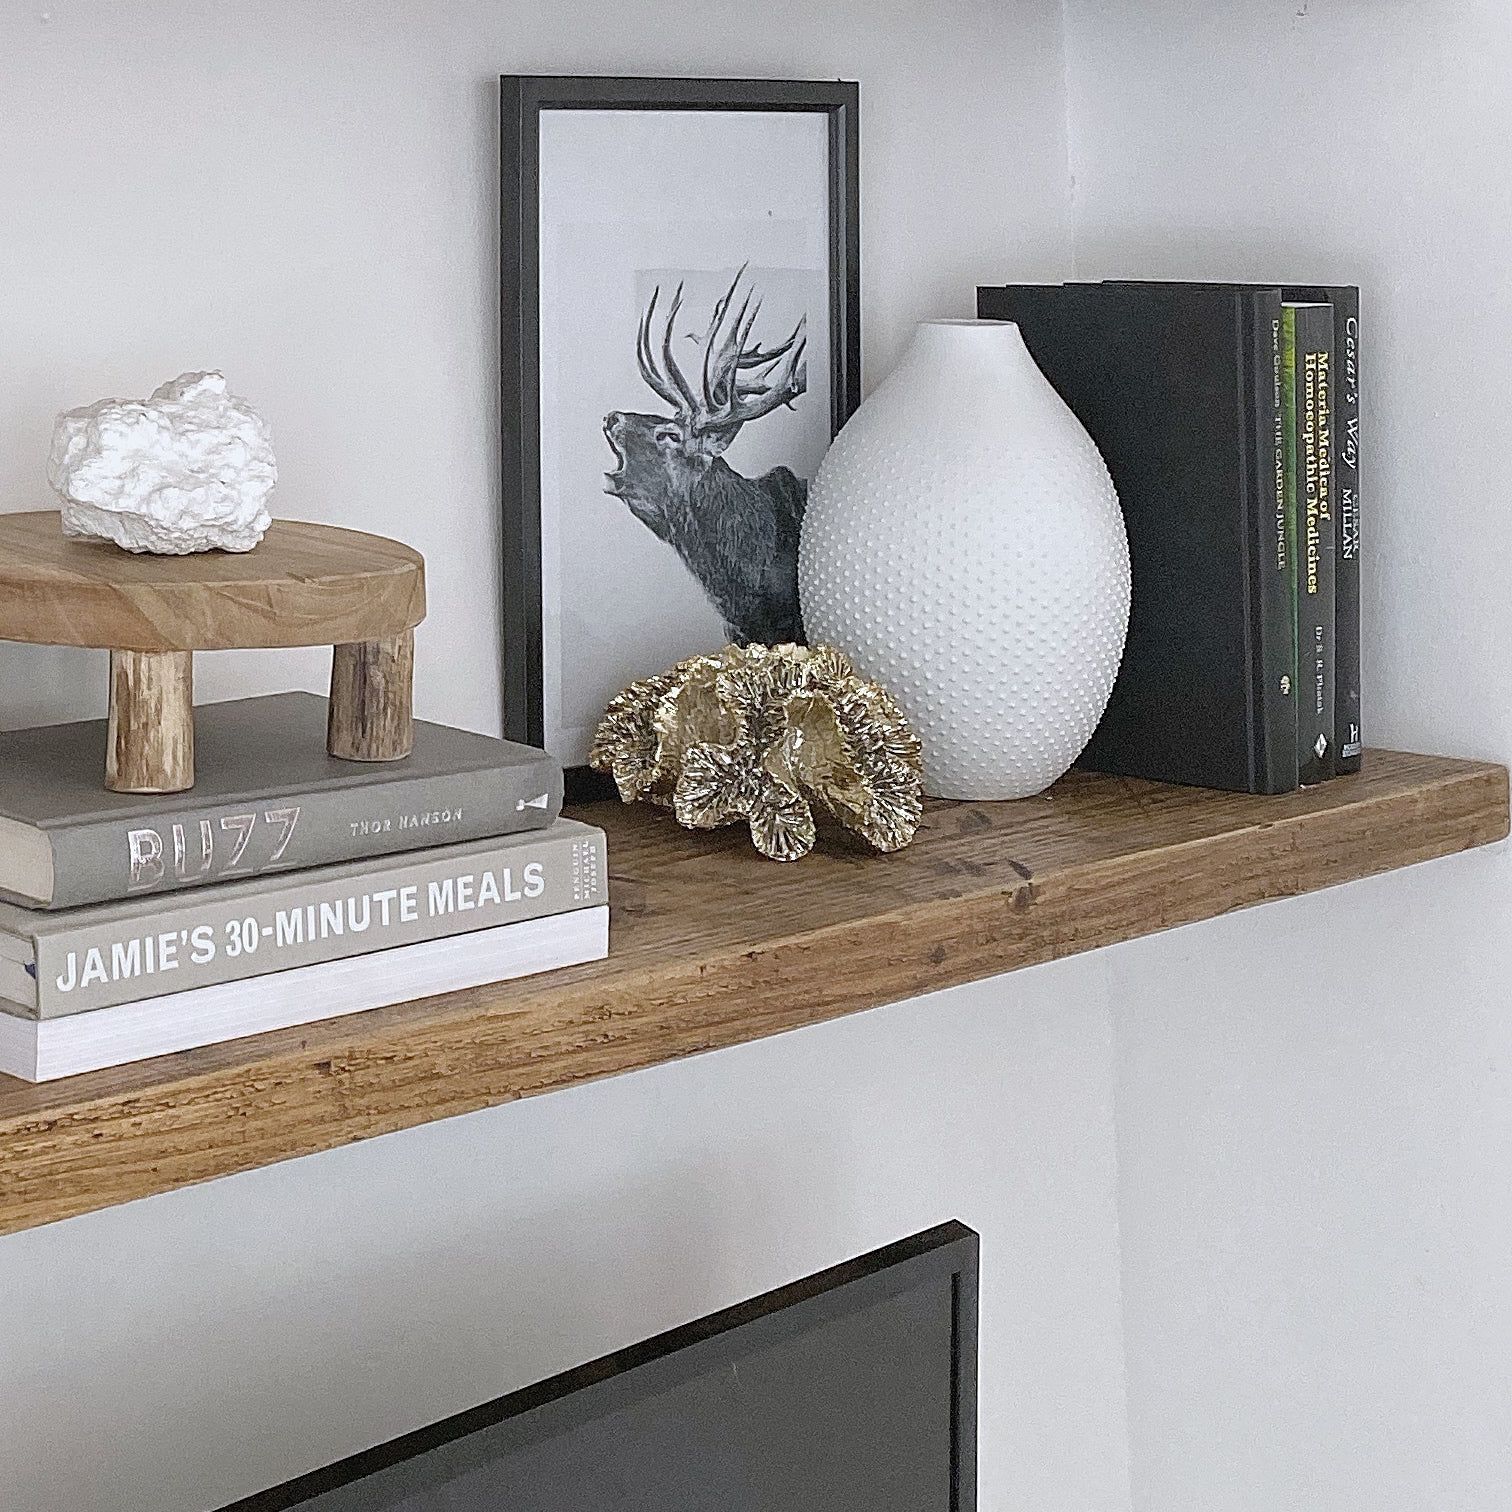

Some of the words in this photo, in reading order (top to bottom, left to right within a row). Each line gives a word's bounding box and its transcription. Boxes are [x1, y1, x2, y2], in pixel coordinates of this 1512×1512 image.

[1272, 319, 1280, 350] Dave
[1346, 317, 1359, 405] Cesar's
[1318, 351, 1330, 427] Materia
[1275, 416, 1284, 445] THE
[1341, 418, 1359, 469] Way
[1274, 448, 1285, 510] GARDEN
[1318, 429, 1331, 498] Medica
[1319, 501, 1331, 521] of
[1342, 488, 1353, 559] MILLAN
[1276, 513, 1286, 570] JUNGLE
[1306, 497, 1320, 594] Medicines
[349, 820, 392, 837] THOR
[398, 807, 464, 830] HANSON
[572, 843, 580, 900] PENGUIN
[582, 840, 590, 900] MICHAEL
[589, 844, 597, 893] JOSEPH
[55, 925, 216, 992] JAMIE'S
[225, 885, 419, 957] 30-MINUTE
[427, 861, 546, 915] MEALS
